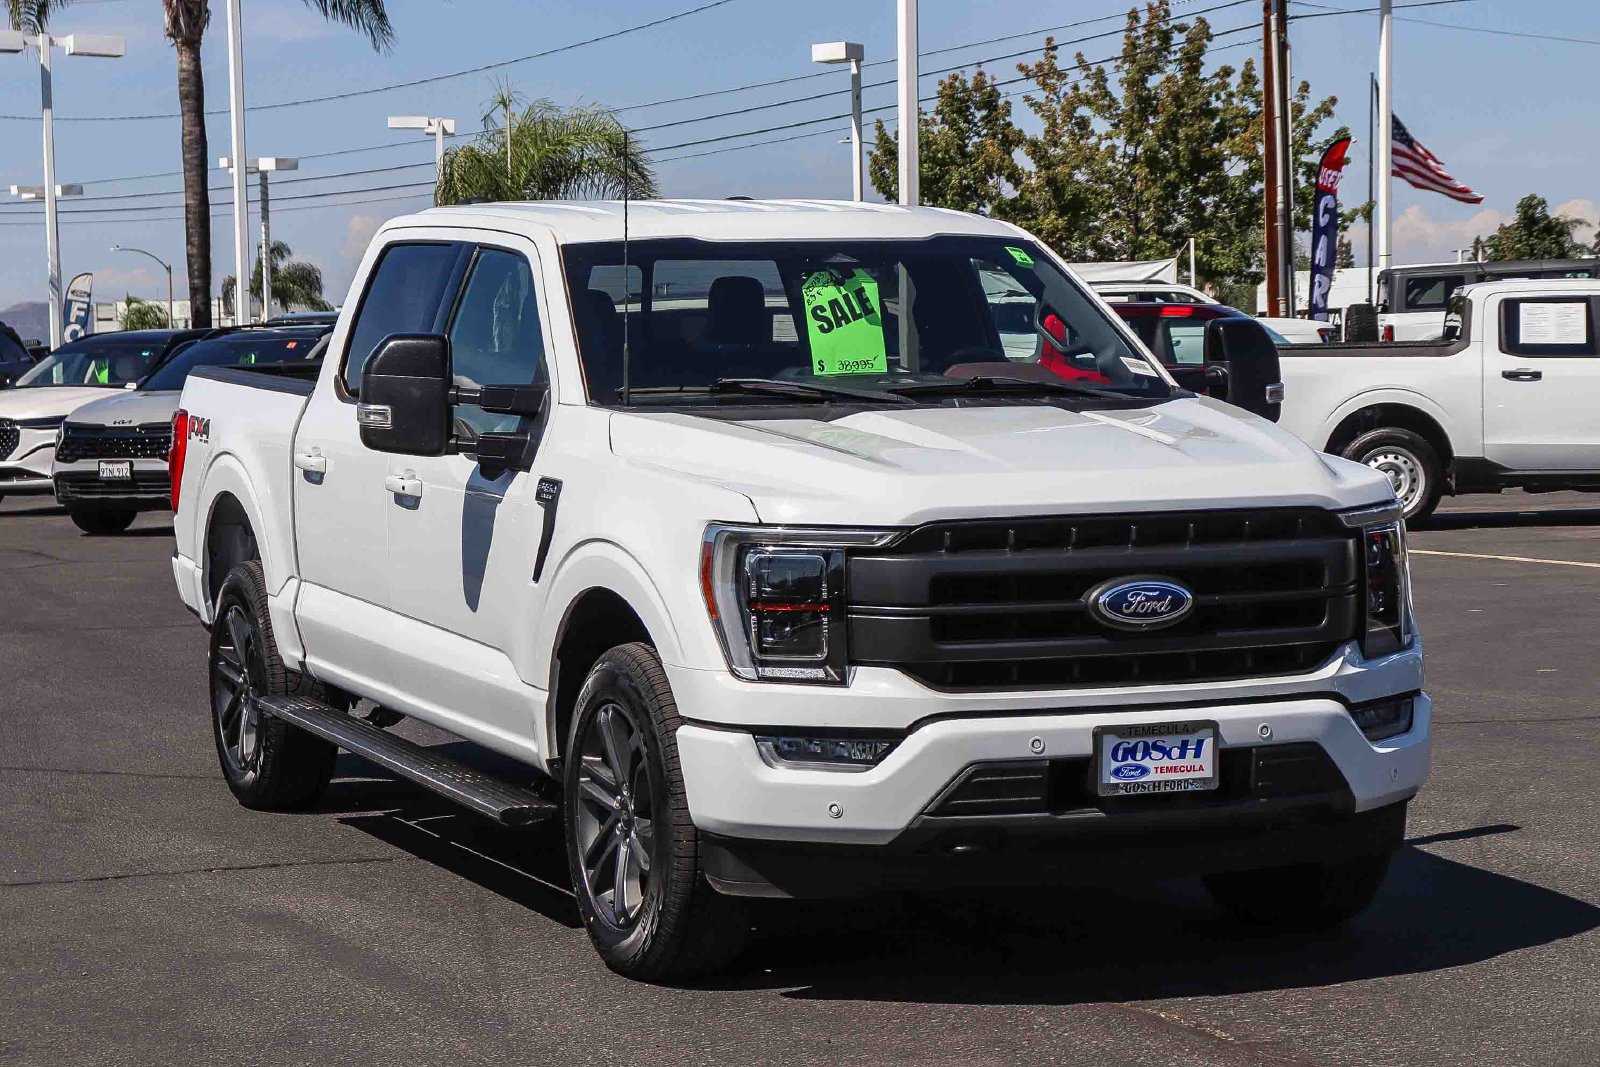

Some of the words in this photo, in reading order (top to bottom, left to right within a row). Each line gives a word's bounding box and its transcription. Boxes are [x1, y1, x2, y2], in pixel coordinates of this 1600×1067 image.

[810, 286, 876, 334] SALE
[188, 414, 211, 440] FX4
[1122, 590, 1172, 614] Ford
[1127, 723, 1189, 736] TEMECULA
[1153, 764, 1205, 774] TEMECULA
[1163, 779, 1190, 791] FORD
